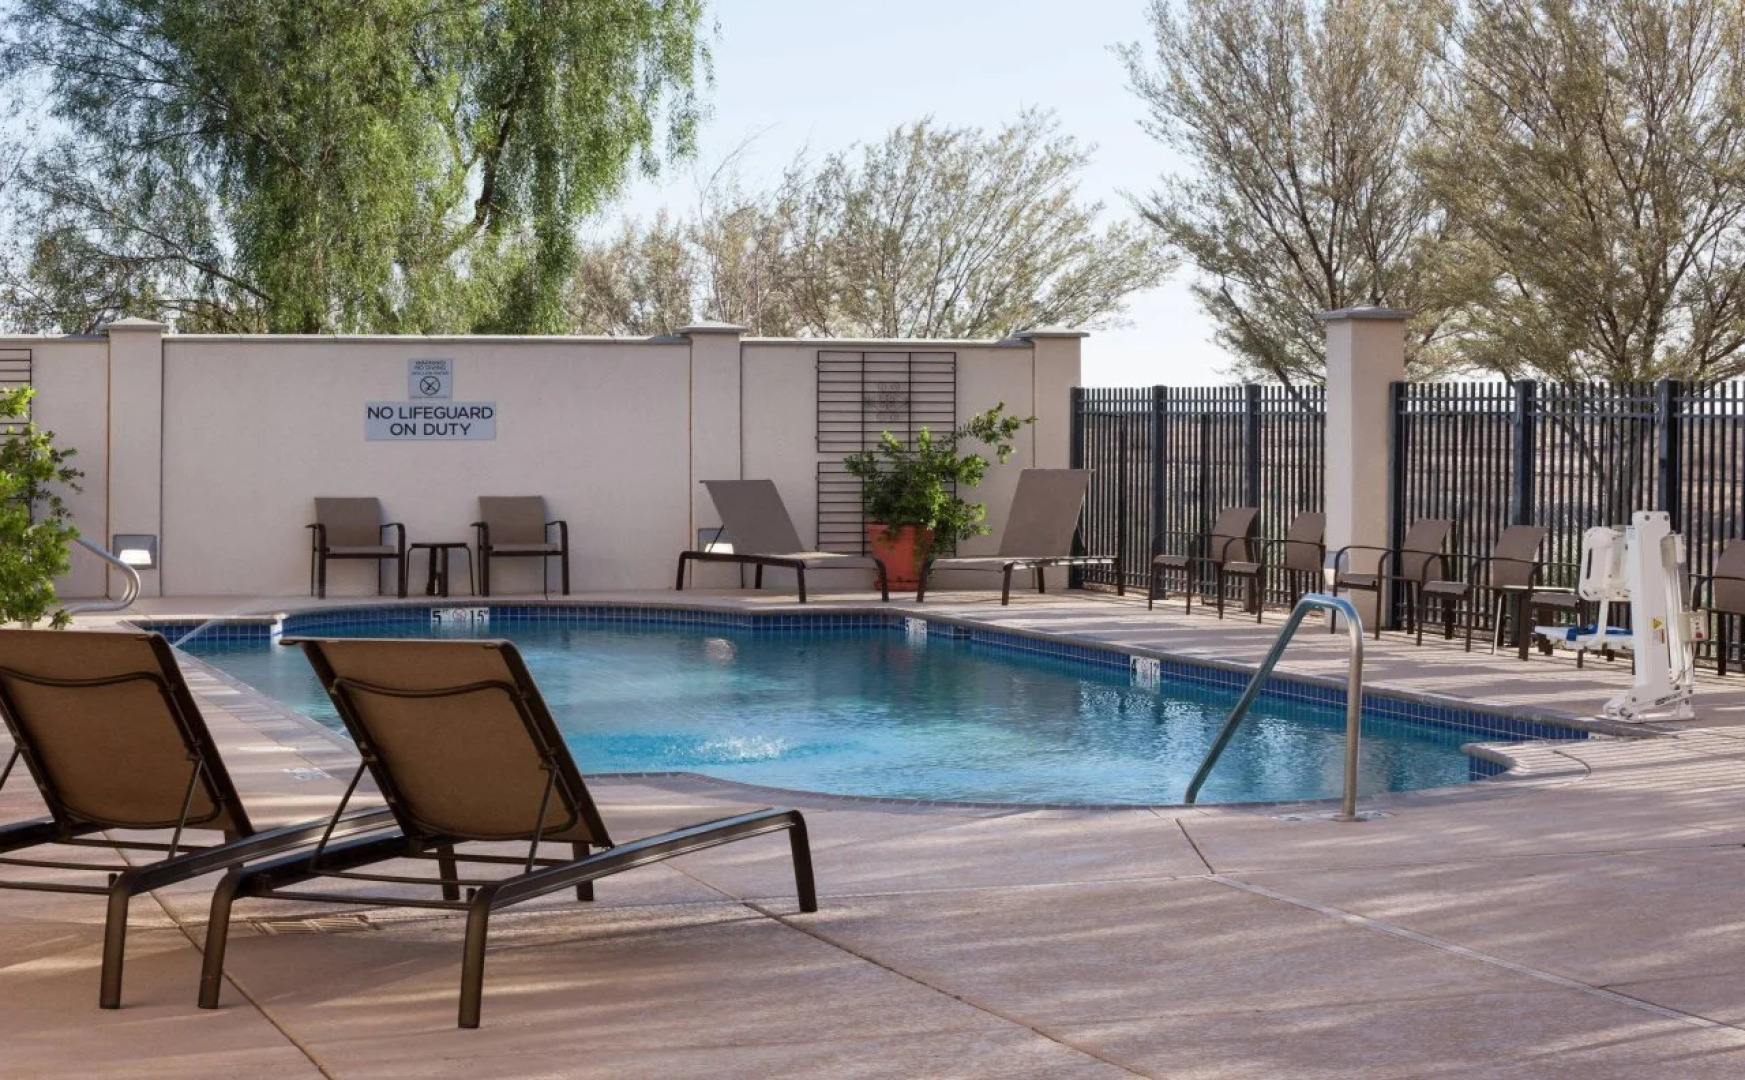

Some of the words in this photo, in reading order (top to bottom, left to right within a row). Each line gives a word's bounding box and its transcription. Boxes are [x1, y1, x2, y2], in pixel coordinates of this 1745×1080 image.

[367, 406, 394, 419] NO
[398, 406, 493, 419] LIFEGUARD
[390, 423, 416, 435] ON
[423, 423, 471, 435] DUTY
